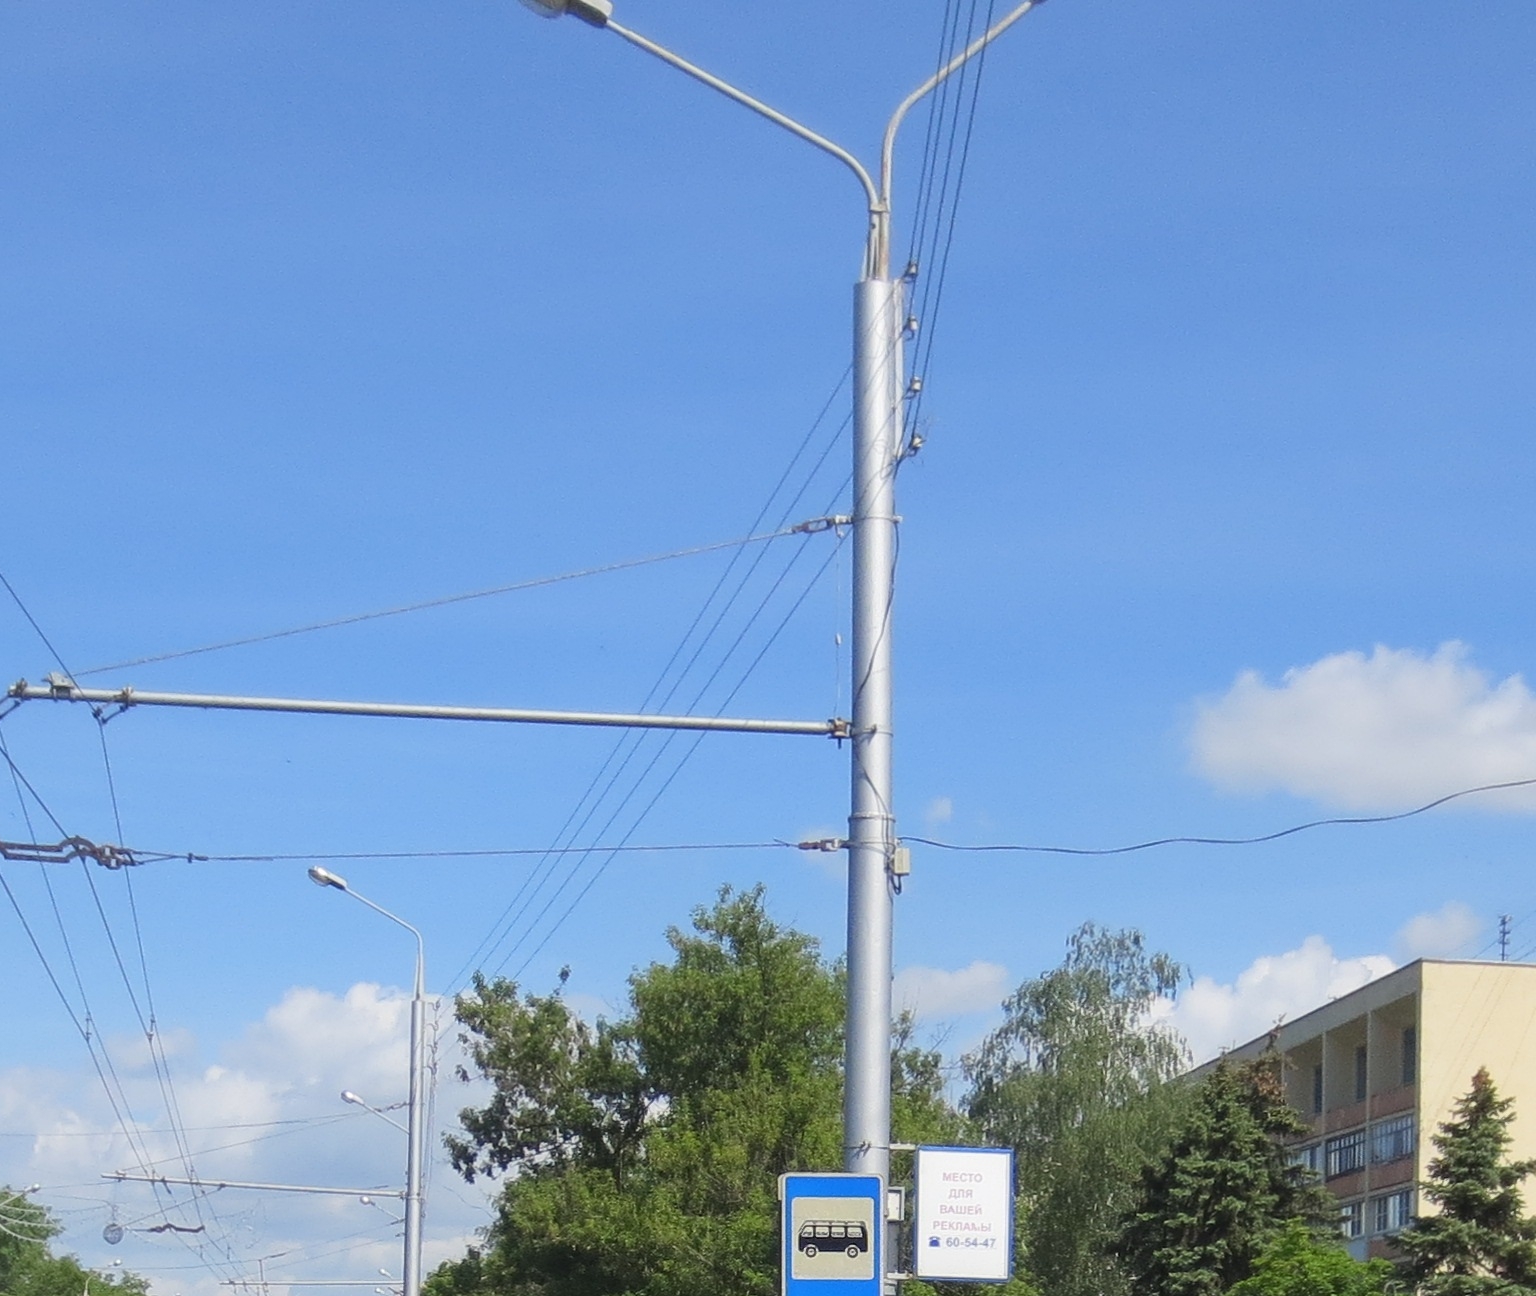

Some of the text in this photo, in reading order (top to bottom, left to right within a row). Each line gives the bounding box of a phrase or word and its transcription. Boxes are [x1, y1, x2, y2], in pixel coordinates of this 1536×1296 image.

[942, 1172, 983, 1183] МЕСТО
[948, 1188, 973, 1199] ДЛЯ
[939, 1204, 983, 1215] ВАШЕЙ
[932, 1220, 992, 1232] РЕКЛАМЫ
[945, 1236, 997, 1248] 60-54-47
